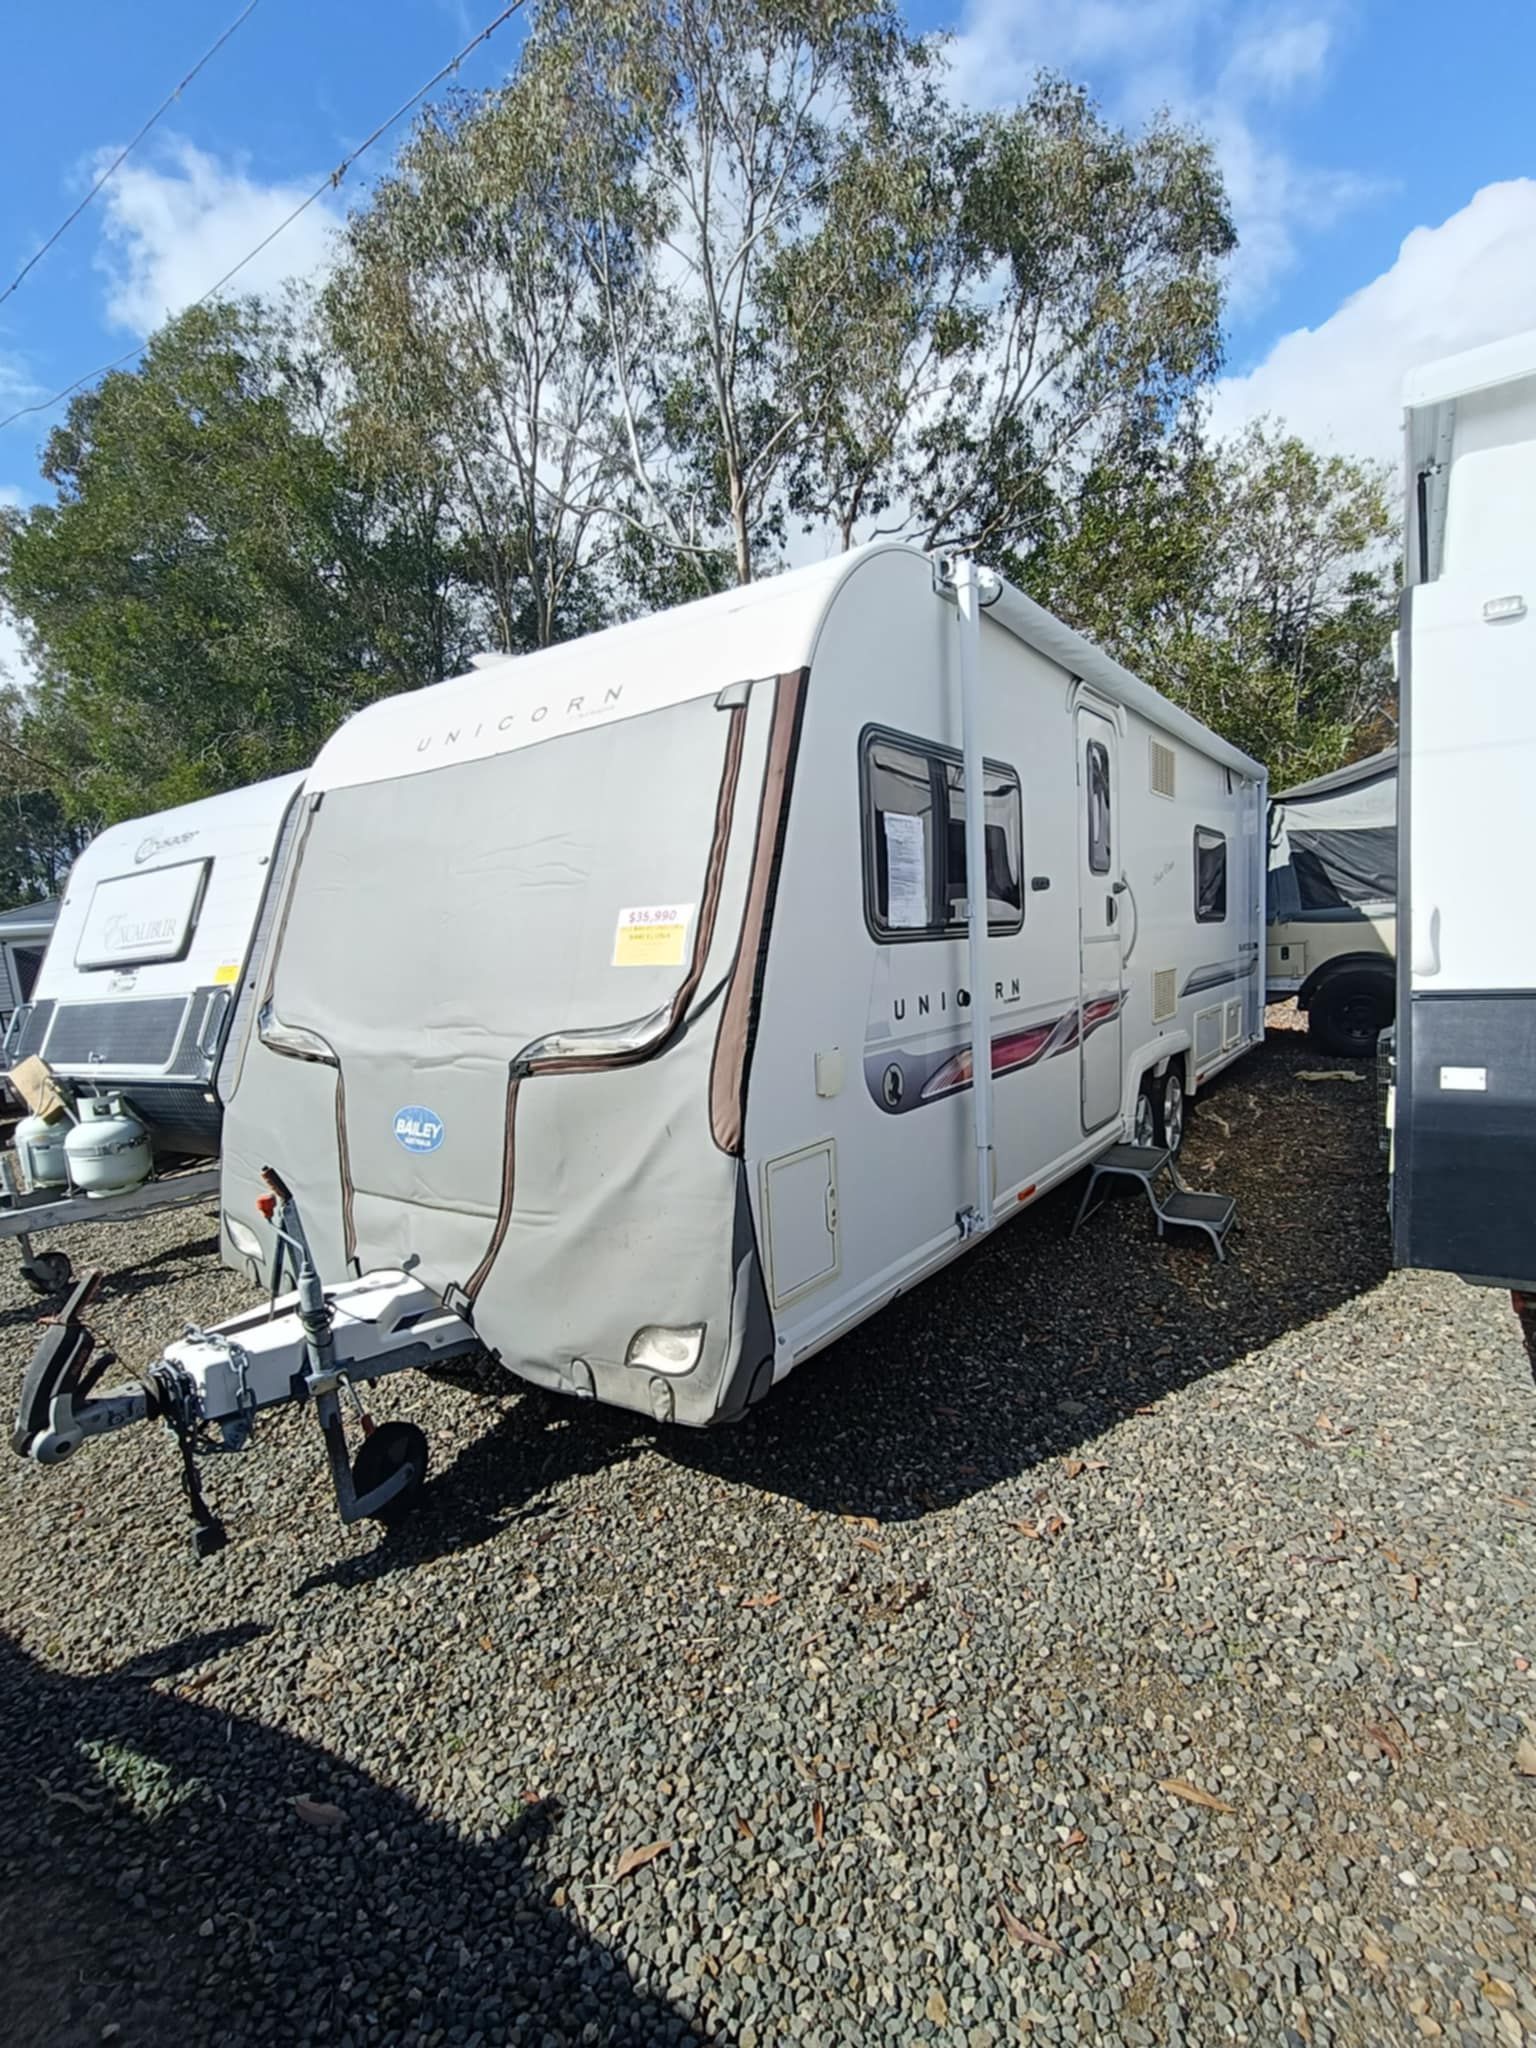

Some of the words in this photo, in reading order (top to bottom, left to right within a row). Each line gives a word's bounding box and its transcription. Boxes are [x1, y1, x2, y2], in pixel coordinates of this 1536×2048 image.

[416, 683, 625, 752] UNICORN
[628, 909, 678, 923] $35,990
[894, 978, 1021, 1020] UNICRN
[396, 1117, 442, 1139] BAILEY
